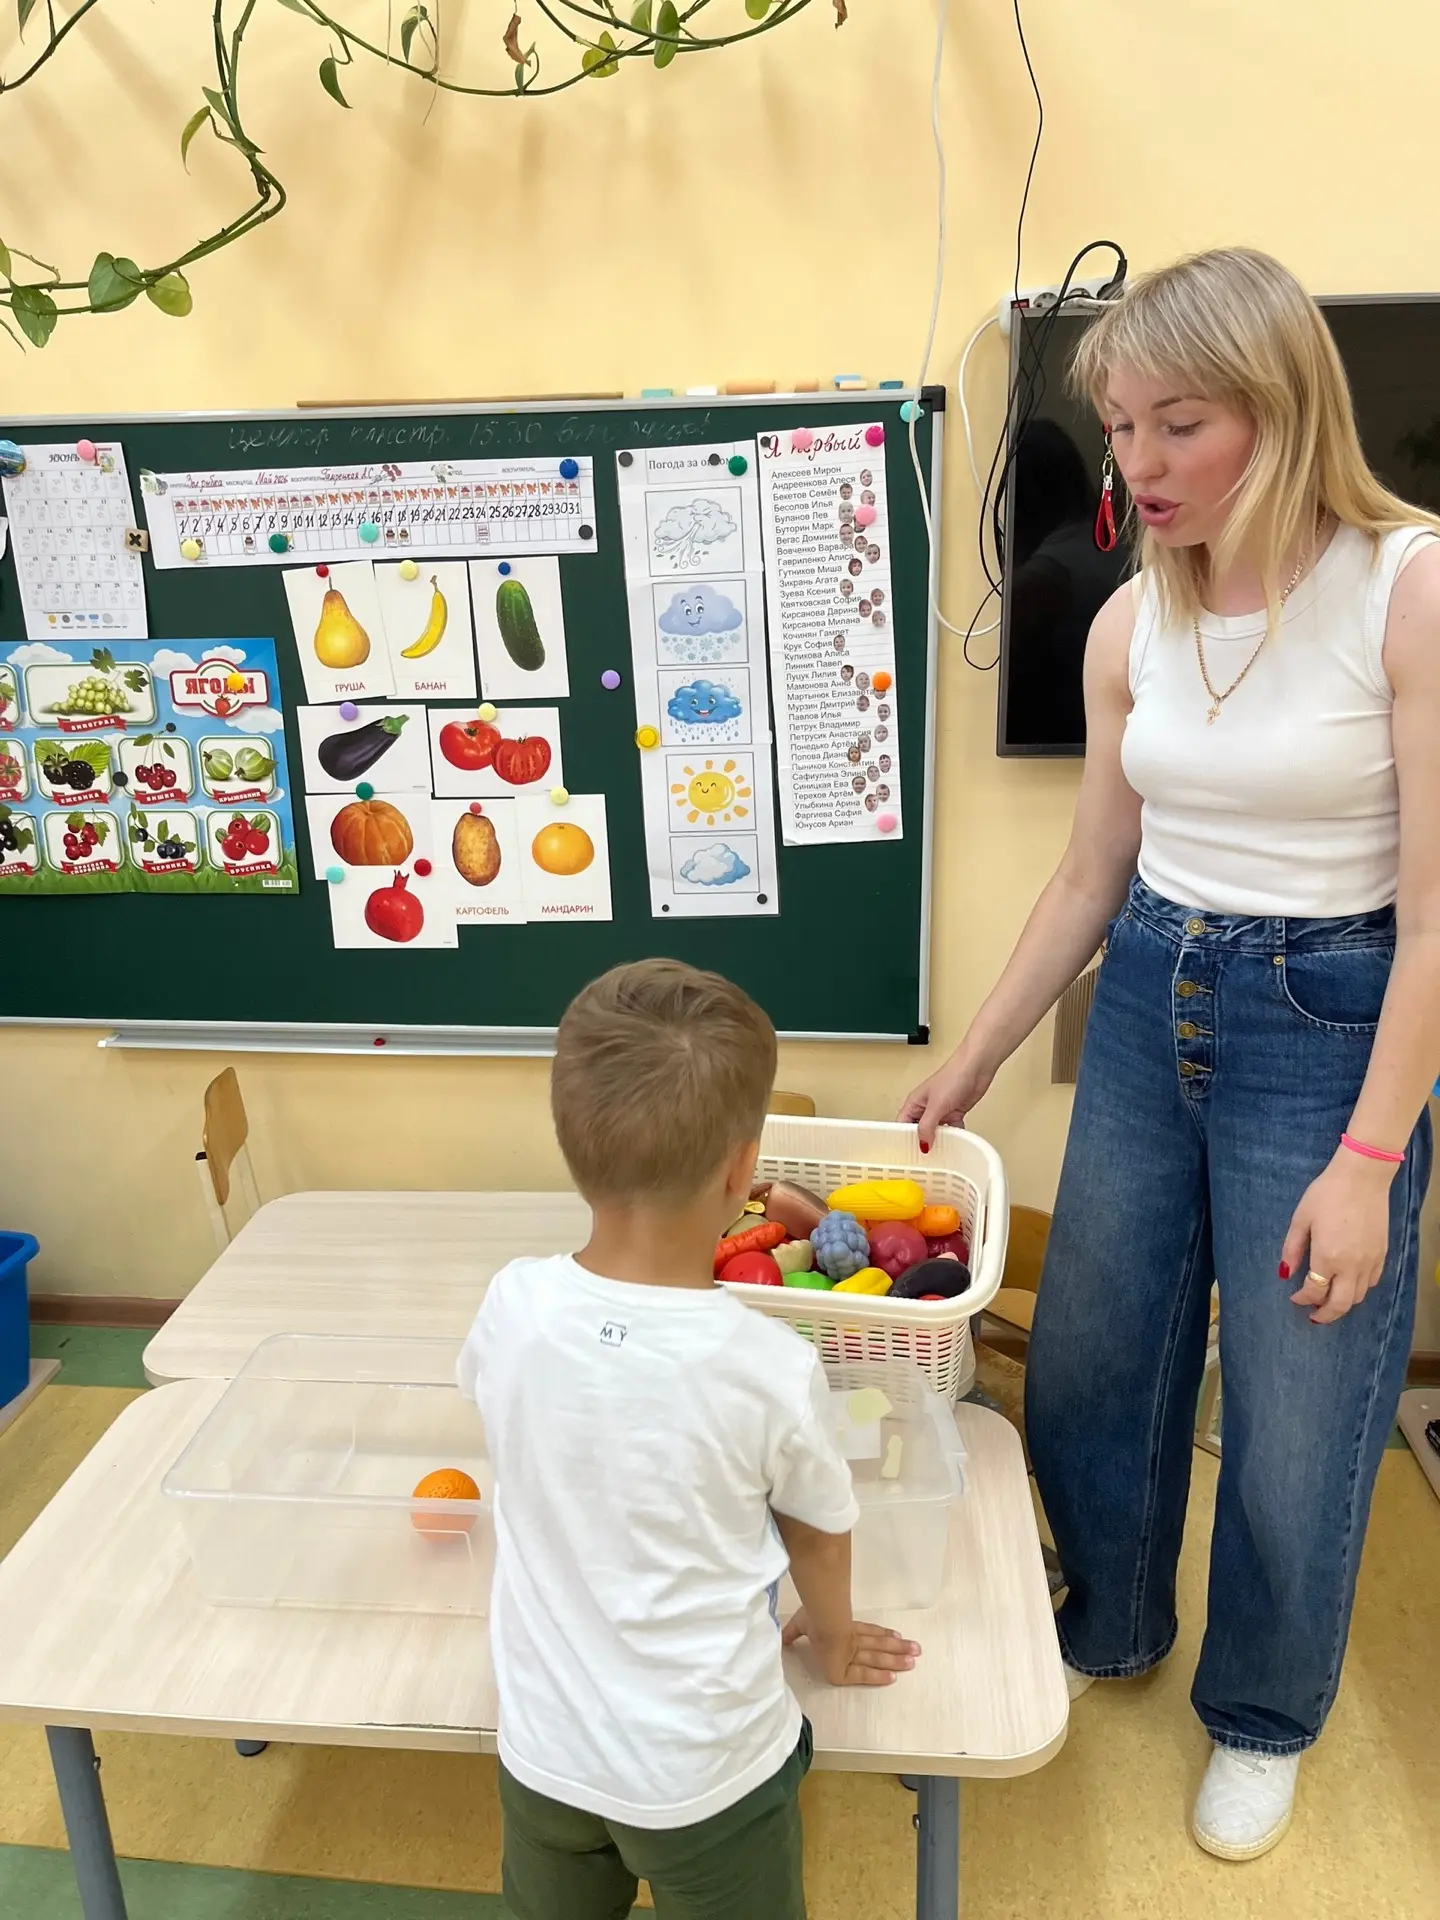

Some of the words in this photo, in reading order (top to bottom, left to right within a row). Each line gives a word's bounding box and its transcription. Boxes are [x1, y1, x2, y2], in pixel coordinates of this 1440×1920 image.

[764, 435, 781, 459] Я
[649, 459, 684, 470] Погода
[255, 472, 272, 485] Май
[771, 469, 811, 479] Алексеев
[814, 467, 841, 476] Мирон
[772, 480, 827, 490] Андреенкова
[773, 492, 806, 501] Бекетов
[809, 489, 837, 497] Семён
[774, 503, 809, 512] Бесолов
[179, 518, 187, 535] 1
[192, 518, 201, 533] 2
[217, 516, 227, 534] 4
[243, 517, 250, 530] 6
[267, 515, 276, 531] 8
[281, 515, 288, 529] 9
[293, 515, 302, 529] 10
[305, 515, 314, 528] 11
[318, 514, 328, 527] 12
[331, 513, 342, 527] 13
[344, 512, 354, 526] 14
[357, 512, 366, 524] 15
[371, 512, 381, 523] 16
[384, 509, 393, 522] 17
[398, 509, 406, 522] 18
[410, 509, 420, 521] 19
[423, 509, 434, 522] 20
[435, 508, 445, 521] 21
[449, 508, 460, 521] 22
[462, 507, 474, 519] 23
[476, 507, 486, 519] 24
[489, 506, 501, 518] 25
[502, 506, 514, 518] 26
[515, 505, 527, 518] 27
[528, 504, 541, 518] 28
[542, 504, 554, 515] 29
[555, 503, 567, 514] 30
[569, 503, 580, 514] 31
[775, 514, 810, 524] Буланов
[775, 524, 809, 535] Буторин
[812, 522, 834, 531] Марк
[776, 537, 800, 545] Вегас
[802, 534, 839, 544] Доминик
[777, 546, 816, 555] Вовченко
[778, 556, 826, 566] Гавриленко
[828, 553, 854, 561] Алиса
[779, 567, 815, 578] Гутников
[818, 565, 842, 573] Миша
[815, 576, 838, 584] Агата
[780, 590, 804, 599] Зуева
[807, 587, 836, 595] Ксения
[781, 599, 830, 609] Квятковская
[833, 596, 861, 604] София
[782, 610, 825, 619] Кирсанова
[828, 607, 858, 616] Дарина
[783, 621, 826, 630] Кирсанова
[828, 617, 860, 626] Милана
[784, 643, 802, 652] Крук
[804, 641, 832, 649] София
[785, 652, 822, 661] Куликова
[825, 650, 849, 658] Алиса
[785, 662, 814, 670] Линник
[817, 660, 842, 668] Павел
[812, 671, 837, 679] Лилия
[334, 681, 366, 693] ГРУША
[415, 681, 447, 691] БАНАН
[787, 682, 828, 690] Мамонова
[788, 703, 818, 712] Мурзин
[820, 700, 855, 710] Дмитрий
[821, 711, 841, 719] Илья
[71, 718, 115, 731] ВИНОГРАД
[789, 723, 817, 731] Петрук
[819, 721, 860, 730] Владимир
[790, 733, 826, 741] Петрусик
[831, 741, 856, 749] Артём
[792, 753, 820, 761] Попова
[823, 752, 848, 760] Диана
[793, 782, 831, 790] Синицкая
[60, 792, 100, 804] ЕЖЕВИКА
[146, 793, 175, 801] ВИШНЯ
[219, 792, 261, 803] КРЫЖОВНИК
[794, 792, 826, 801] Терехов
[829, 790, 853, 799] Артём
[794, 801, 833, 810] Улыбкина
[836, 800, 860, 808] Арина
[795, 811, 832, 820] Фаргиева
[835, 810, 861, 818] Сафия
[796, 821, 826, 830] Юнусов
[829, 820, 853, 828] Ариан
[150, 862, 187, 872] ЧЕРНИКА
[229, 863, 271, 874] БРУСНИКА
[456, 906, 509, 916] КАРТОФЕЛЬ
[541, 905, 594, 914] МАНДАРИН
